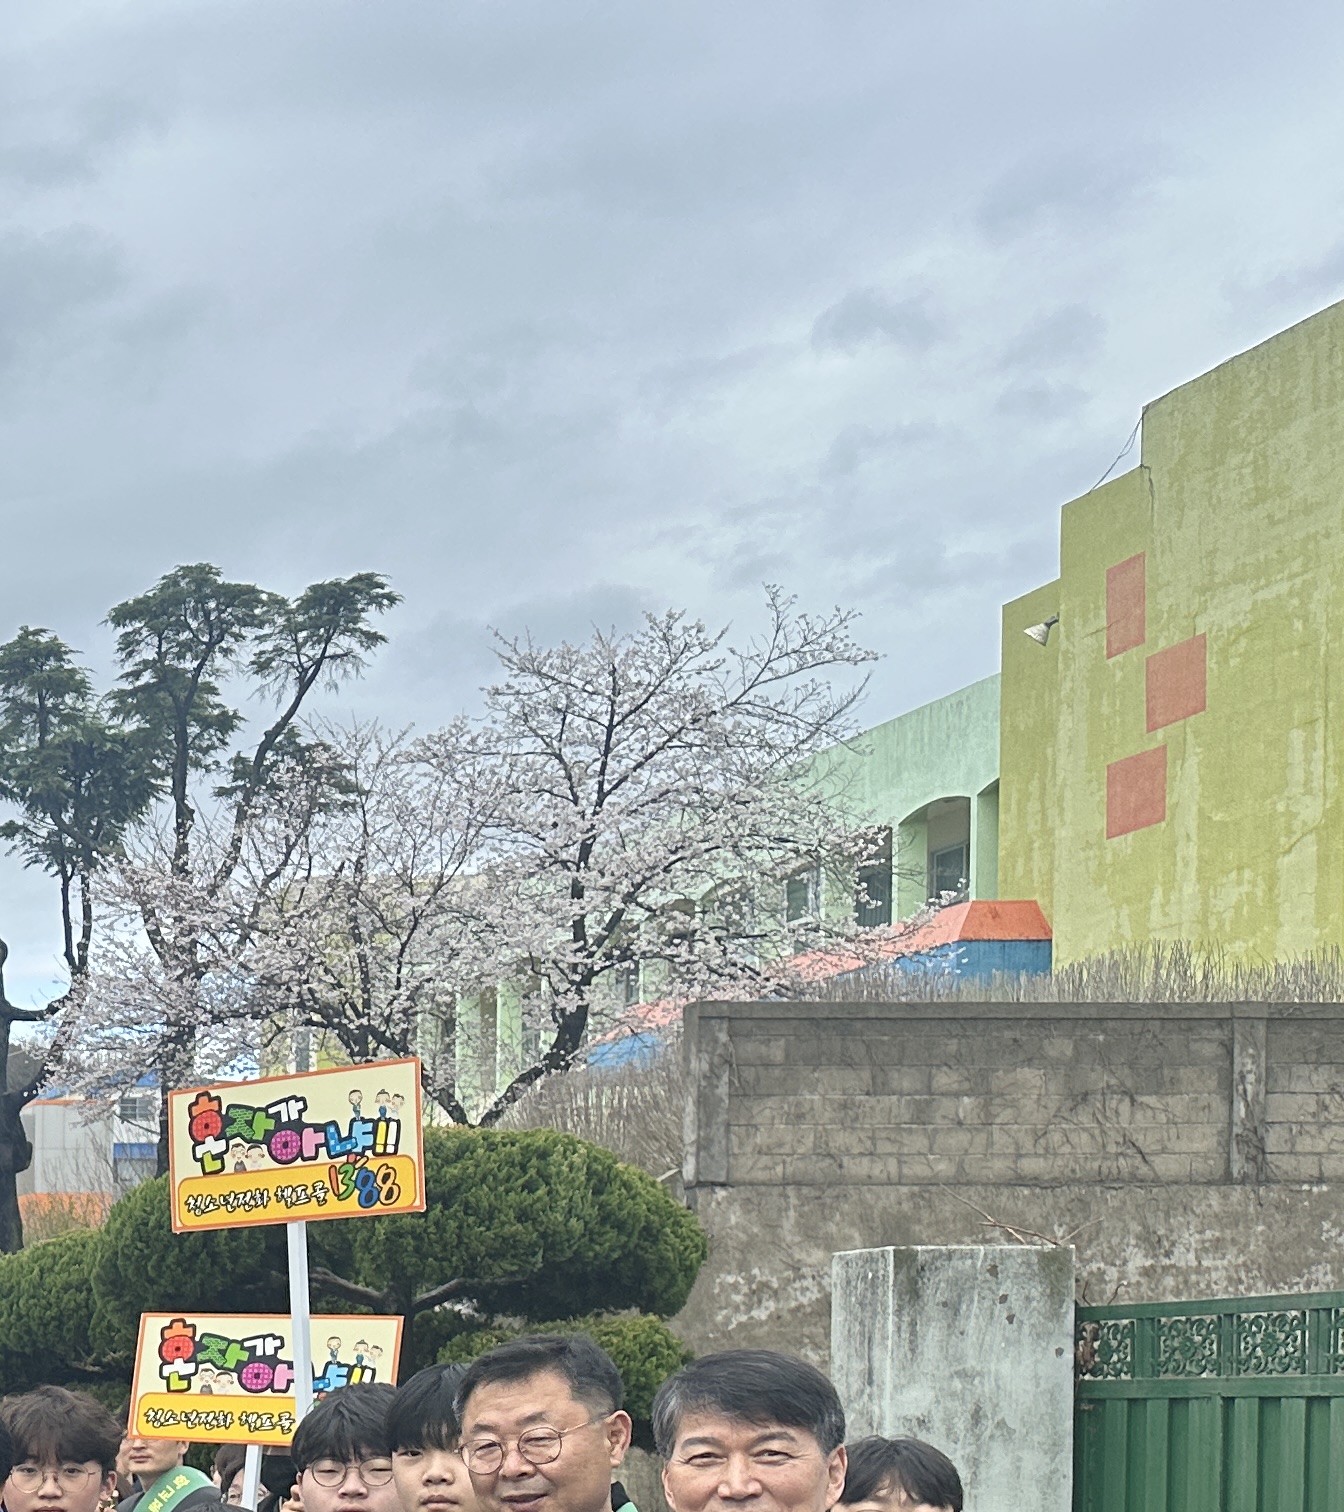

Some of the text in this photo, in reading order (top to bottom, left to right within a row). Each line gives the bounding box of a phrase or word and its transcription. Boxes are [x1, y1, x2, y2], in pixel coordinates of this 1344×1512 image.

[188, 1091, 307, 1174] 혼자가
[185, 1188, 271, 1217] 청소년전화
[328, 1162, 402, 1208] 1388
[158, 1318, 284, 1392] 혼자가
